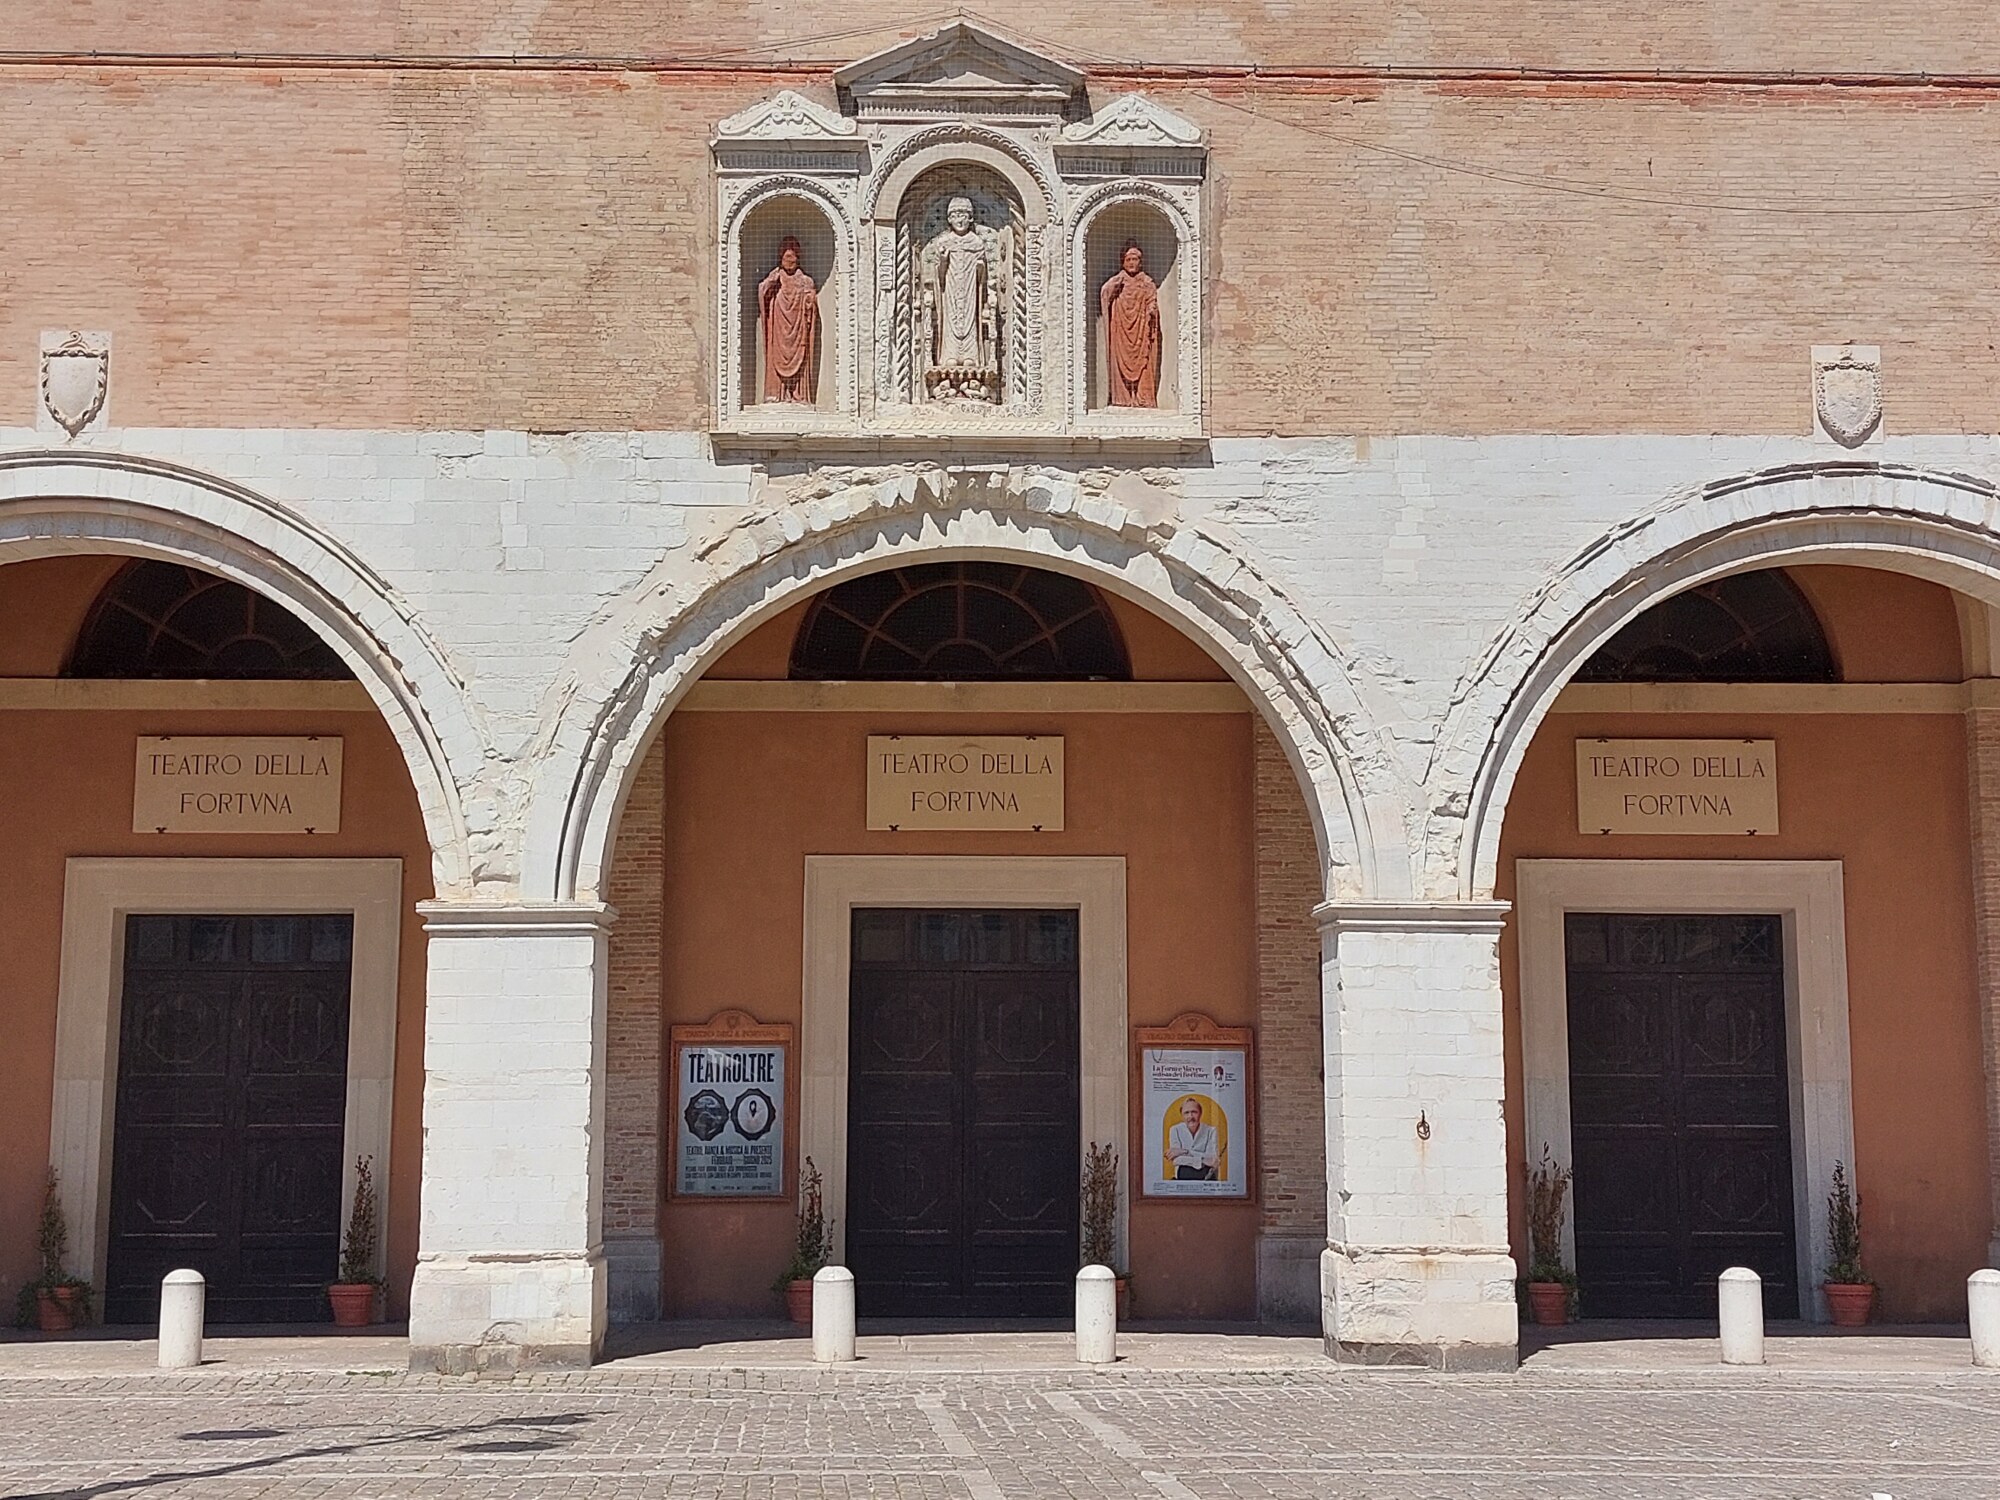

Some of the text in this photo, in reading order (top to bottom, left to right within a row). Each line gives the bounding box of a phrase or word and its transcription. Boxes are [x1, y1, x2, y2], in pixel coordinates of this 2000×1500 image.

[149, 754, 329, 776] TEATRO DELLA
[880, 753, 1053, 774] TEATRO DELLA
[1589, 756, 1766, 778] TEATRO DELLA
[179, 792, 293, 815] FORTVNA
[911, 791, 1019, 812] FORTVNA
[1623, 794, 1732, 816] FORTVNA
[688, 1053, 776, 1083] TEATROLTRE
